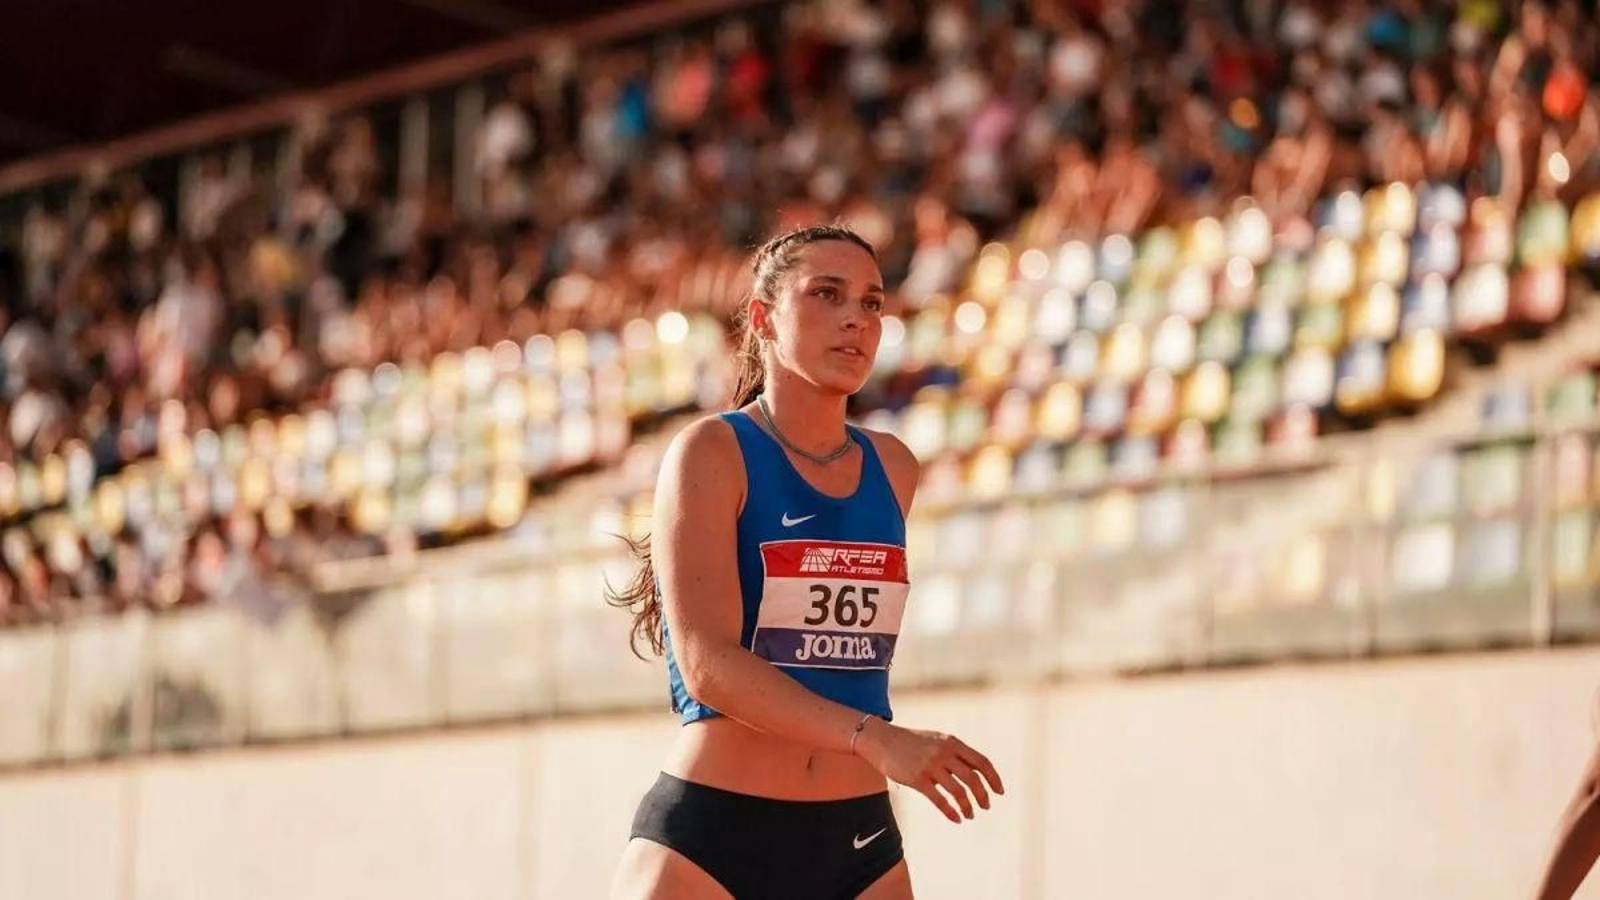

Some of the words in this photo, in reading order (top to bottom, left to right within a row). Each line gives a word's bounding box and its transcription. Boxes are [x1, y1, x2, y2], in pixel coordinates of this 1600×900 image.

[833, 548, 887, 566] RFEA
[830, 565, 884, 575] ATLETISMO
[804, 584, 880, 628] 365
